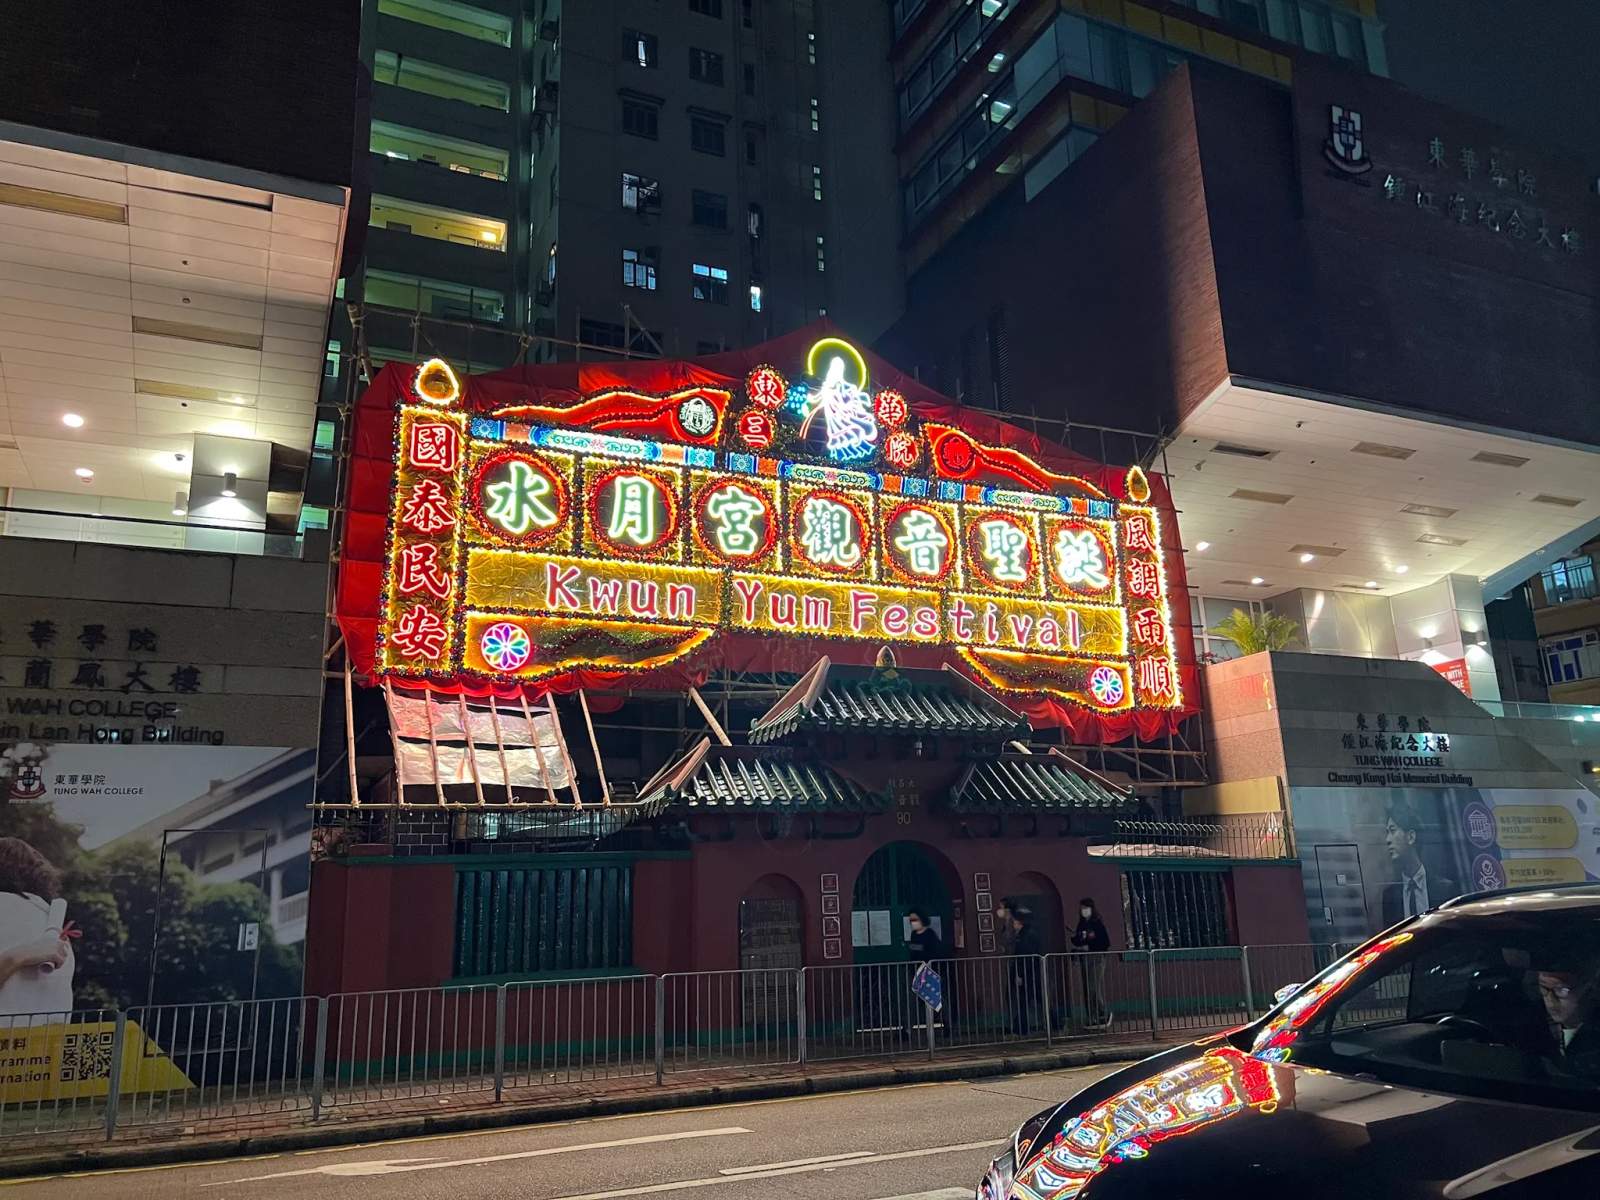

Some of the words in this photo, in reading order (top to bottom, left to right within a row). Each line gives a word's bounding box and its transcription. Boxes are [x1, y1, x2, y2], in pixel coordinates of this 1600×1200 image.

[1427, 136, 1536, 197] 東華學院
[754, 370, 782, 407] 東
[877, 392, 903, 427] 華
[890, 438, 915, 466] 院
[487, 461, 1110, 589] 水月宮觀音聖誕
[393, 423, 457, 661] 國泰民安
[545, 563, 697, 620] Kwun
[733, 579, 831, 630] Yum
[850, 591, 1080, 649] Festival
[1125, 516, 1174, 698] 風調雨順
[0, 619, 158, 652] 華學院
[0, 657, 202, 694] 蘭鳳大樓
[8, 697, 61, 716] WAH
[68, 699, 178, 719] COLLEGE
[1357, 712, 1432, 732] 東華學院
[28, 721, 70, 740] Lan
[78, 723, 134, 745] Hong
[143, 724, 225, 746] Building
[1354, 755, 1381, 767] TUNG
[1381, 756, 1402, 767] WAH
[1403, 756, 1444, 768] COLLEGE
[54, 774, 106, 786] 東華學院
[54, 787, 79, 796] TUNG
[80, 787, 102, 796] WAH
[104, 787, 144, 796] COLLEGE
[1363, 772, 1386, 786] Kung
[1403, 773, 1440, 785] Memorial
[1441, 774, 1473, 787] Building
[896, 811, 911, 825] 90
